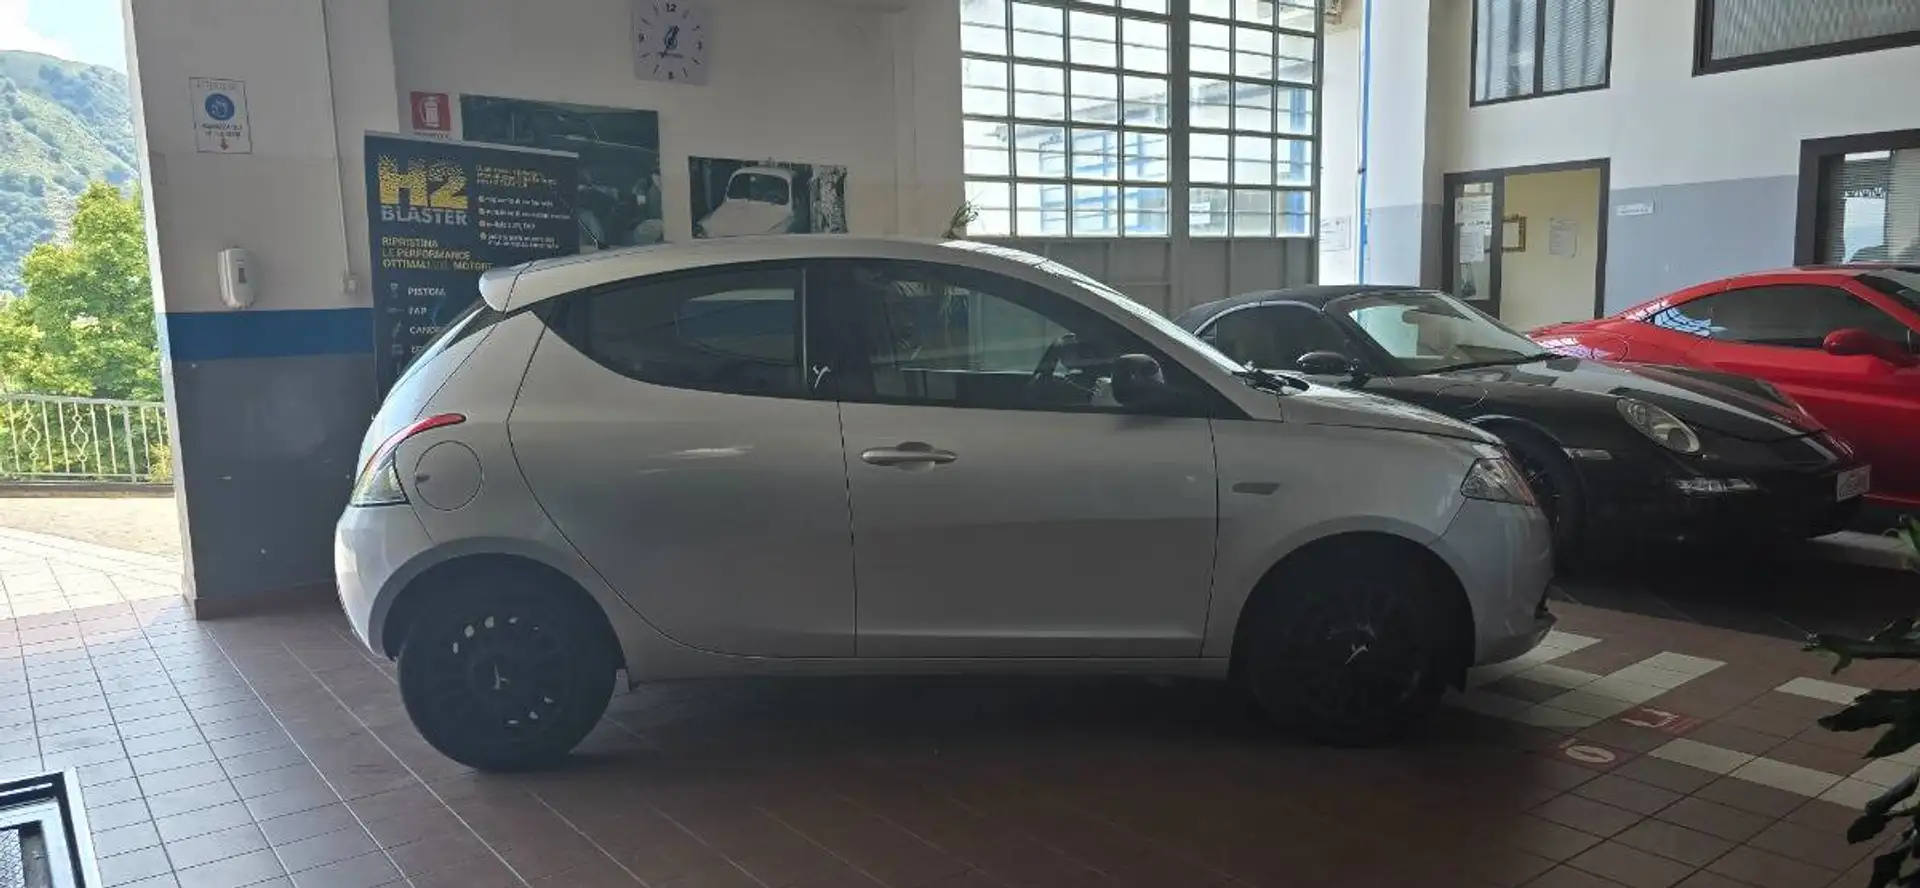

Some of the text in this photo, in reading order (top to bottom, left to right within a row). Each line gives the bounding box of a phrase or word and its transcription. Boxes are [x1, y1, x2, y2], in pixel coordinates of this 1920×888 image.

[666, 3, 677, 13] 12
[379, 155, 468, 210] H2
[382, 207, 467, 225] BLASTER
[382, 236, 438, 248] RIPRISTINA
[396, 248, 471, 261] PERFORMANCE
